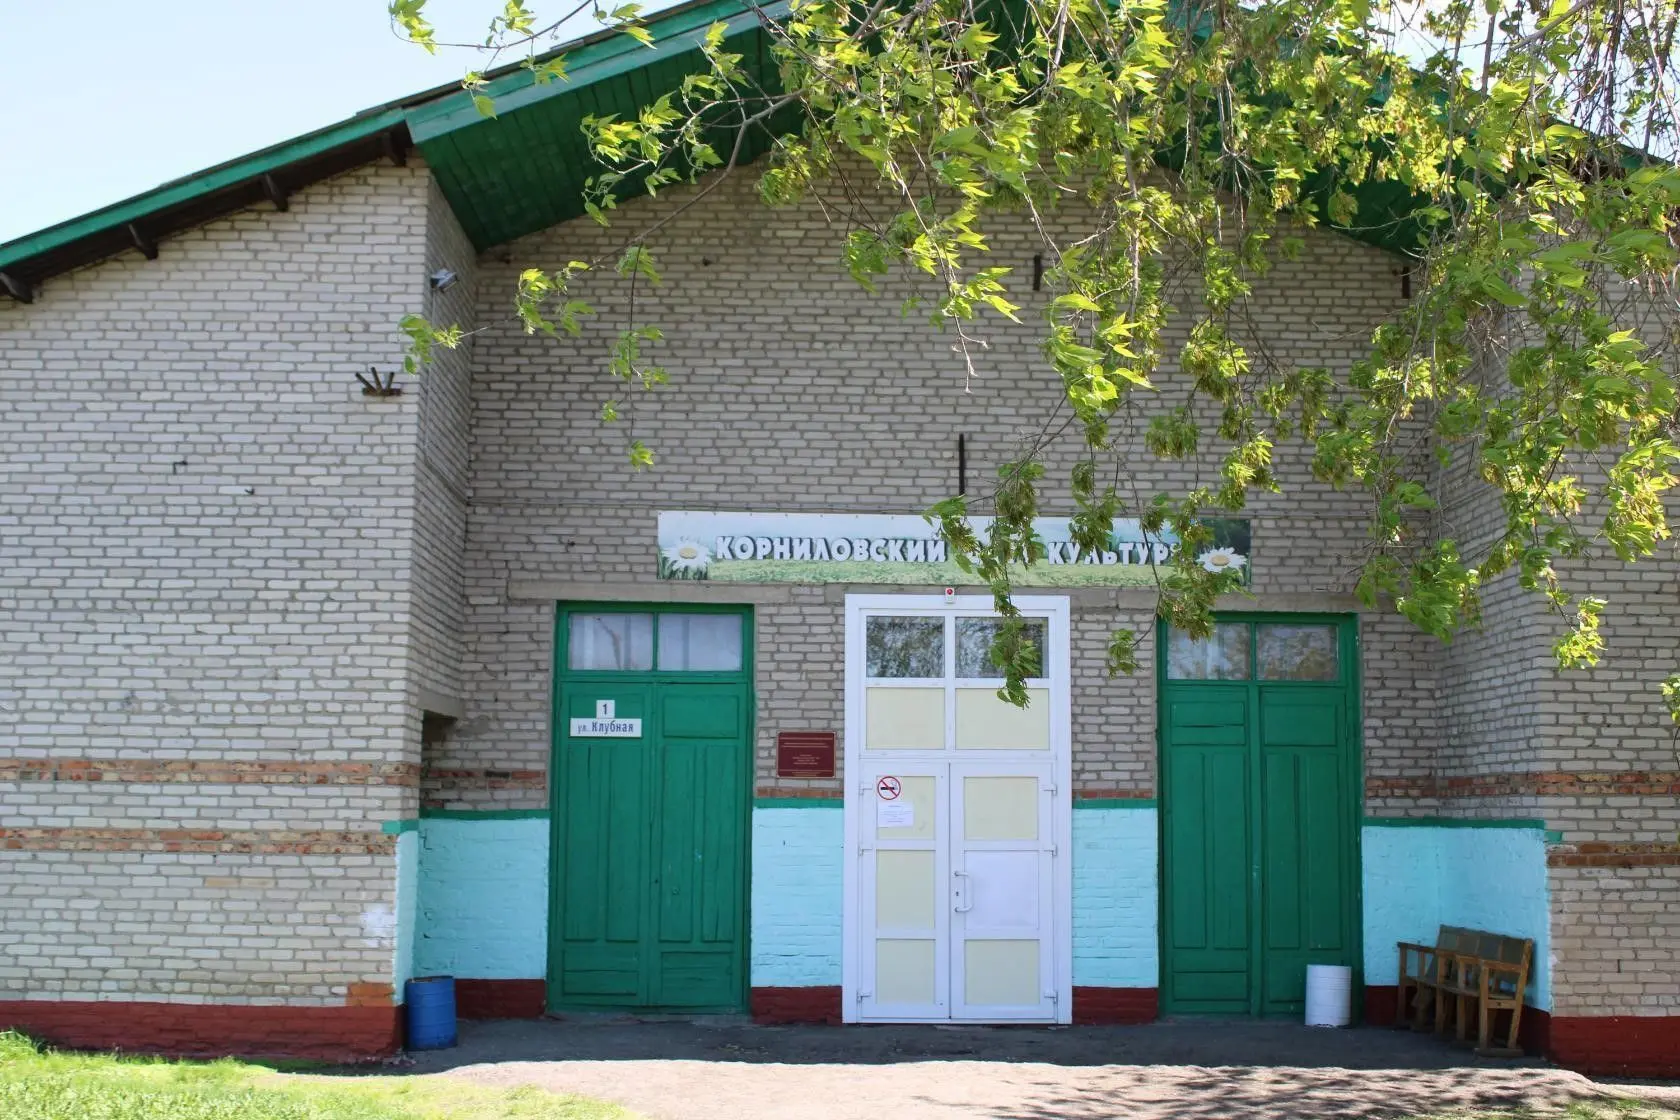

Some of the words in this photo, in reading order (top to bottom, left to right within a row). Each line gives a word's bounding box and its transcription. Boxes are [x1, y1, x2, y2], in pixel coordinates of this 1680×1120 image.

[1047, 541, 1182, 567] КУЛЬТУР
[602, 703, 608, 715] 1
[591, 720, 634, 735] Клубная
